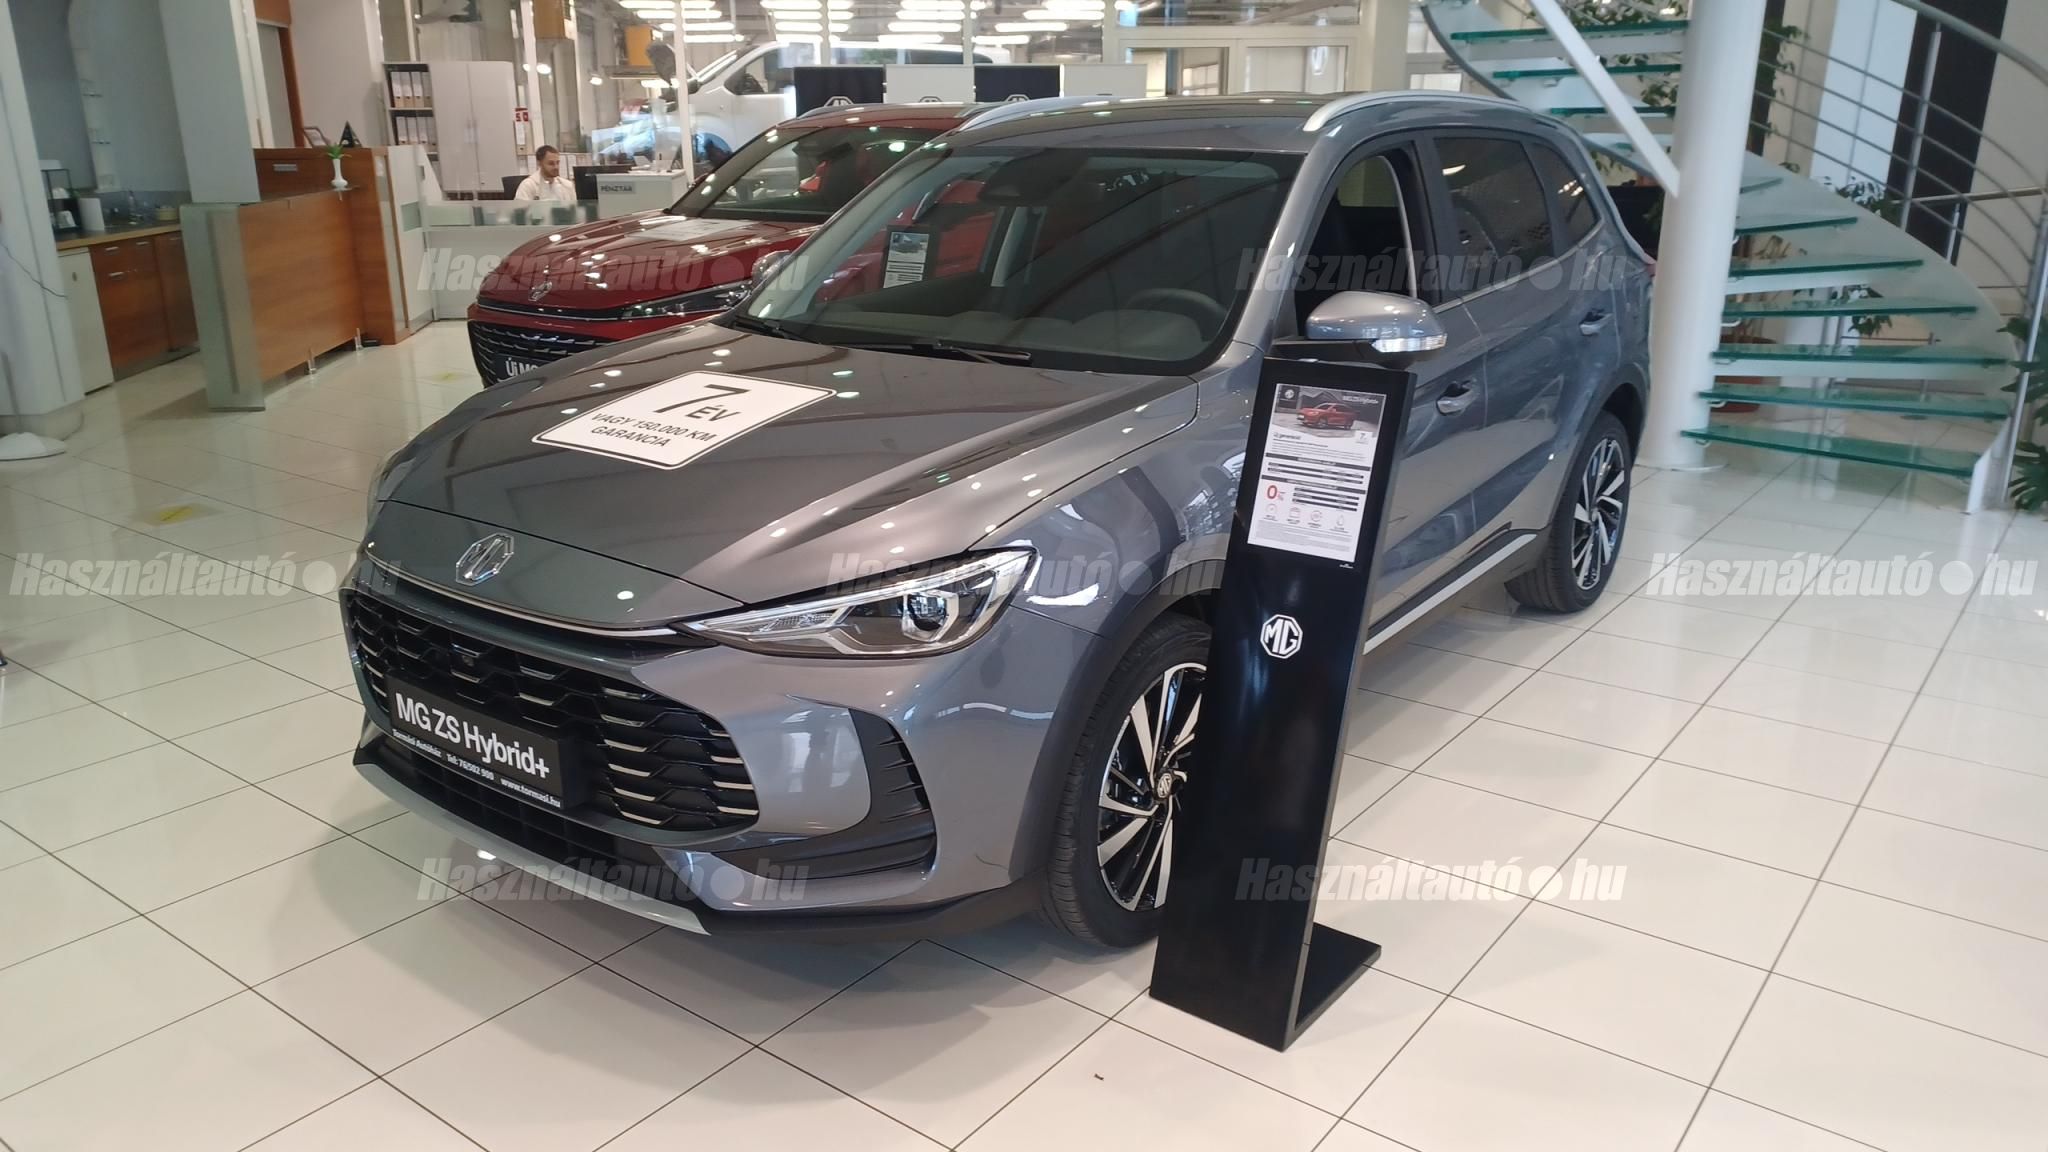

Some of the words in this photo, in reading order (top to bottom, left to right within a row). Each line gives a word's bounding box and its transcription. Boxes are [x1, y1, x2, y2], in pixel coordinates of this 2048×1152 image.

[653, 384, 751, 414] 7
[685, 405, 741, 422] ÉV
[591, 413, 634, 425] VAGY
[633, 420, 689, 436] 150.000
[687, 430, 717, 441] KM
[591, 426, 671, 446] GARANCIA
[1262, 616, 1301, 657] MG
[396, 693, 431, 732] MG
[432, 708, 461, 743] ZS
[462, 721, 550, 779] Hybrid+
